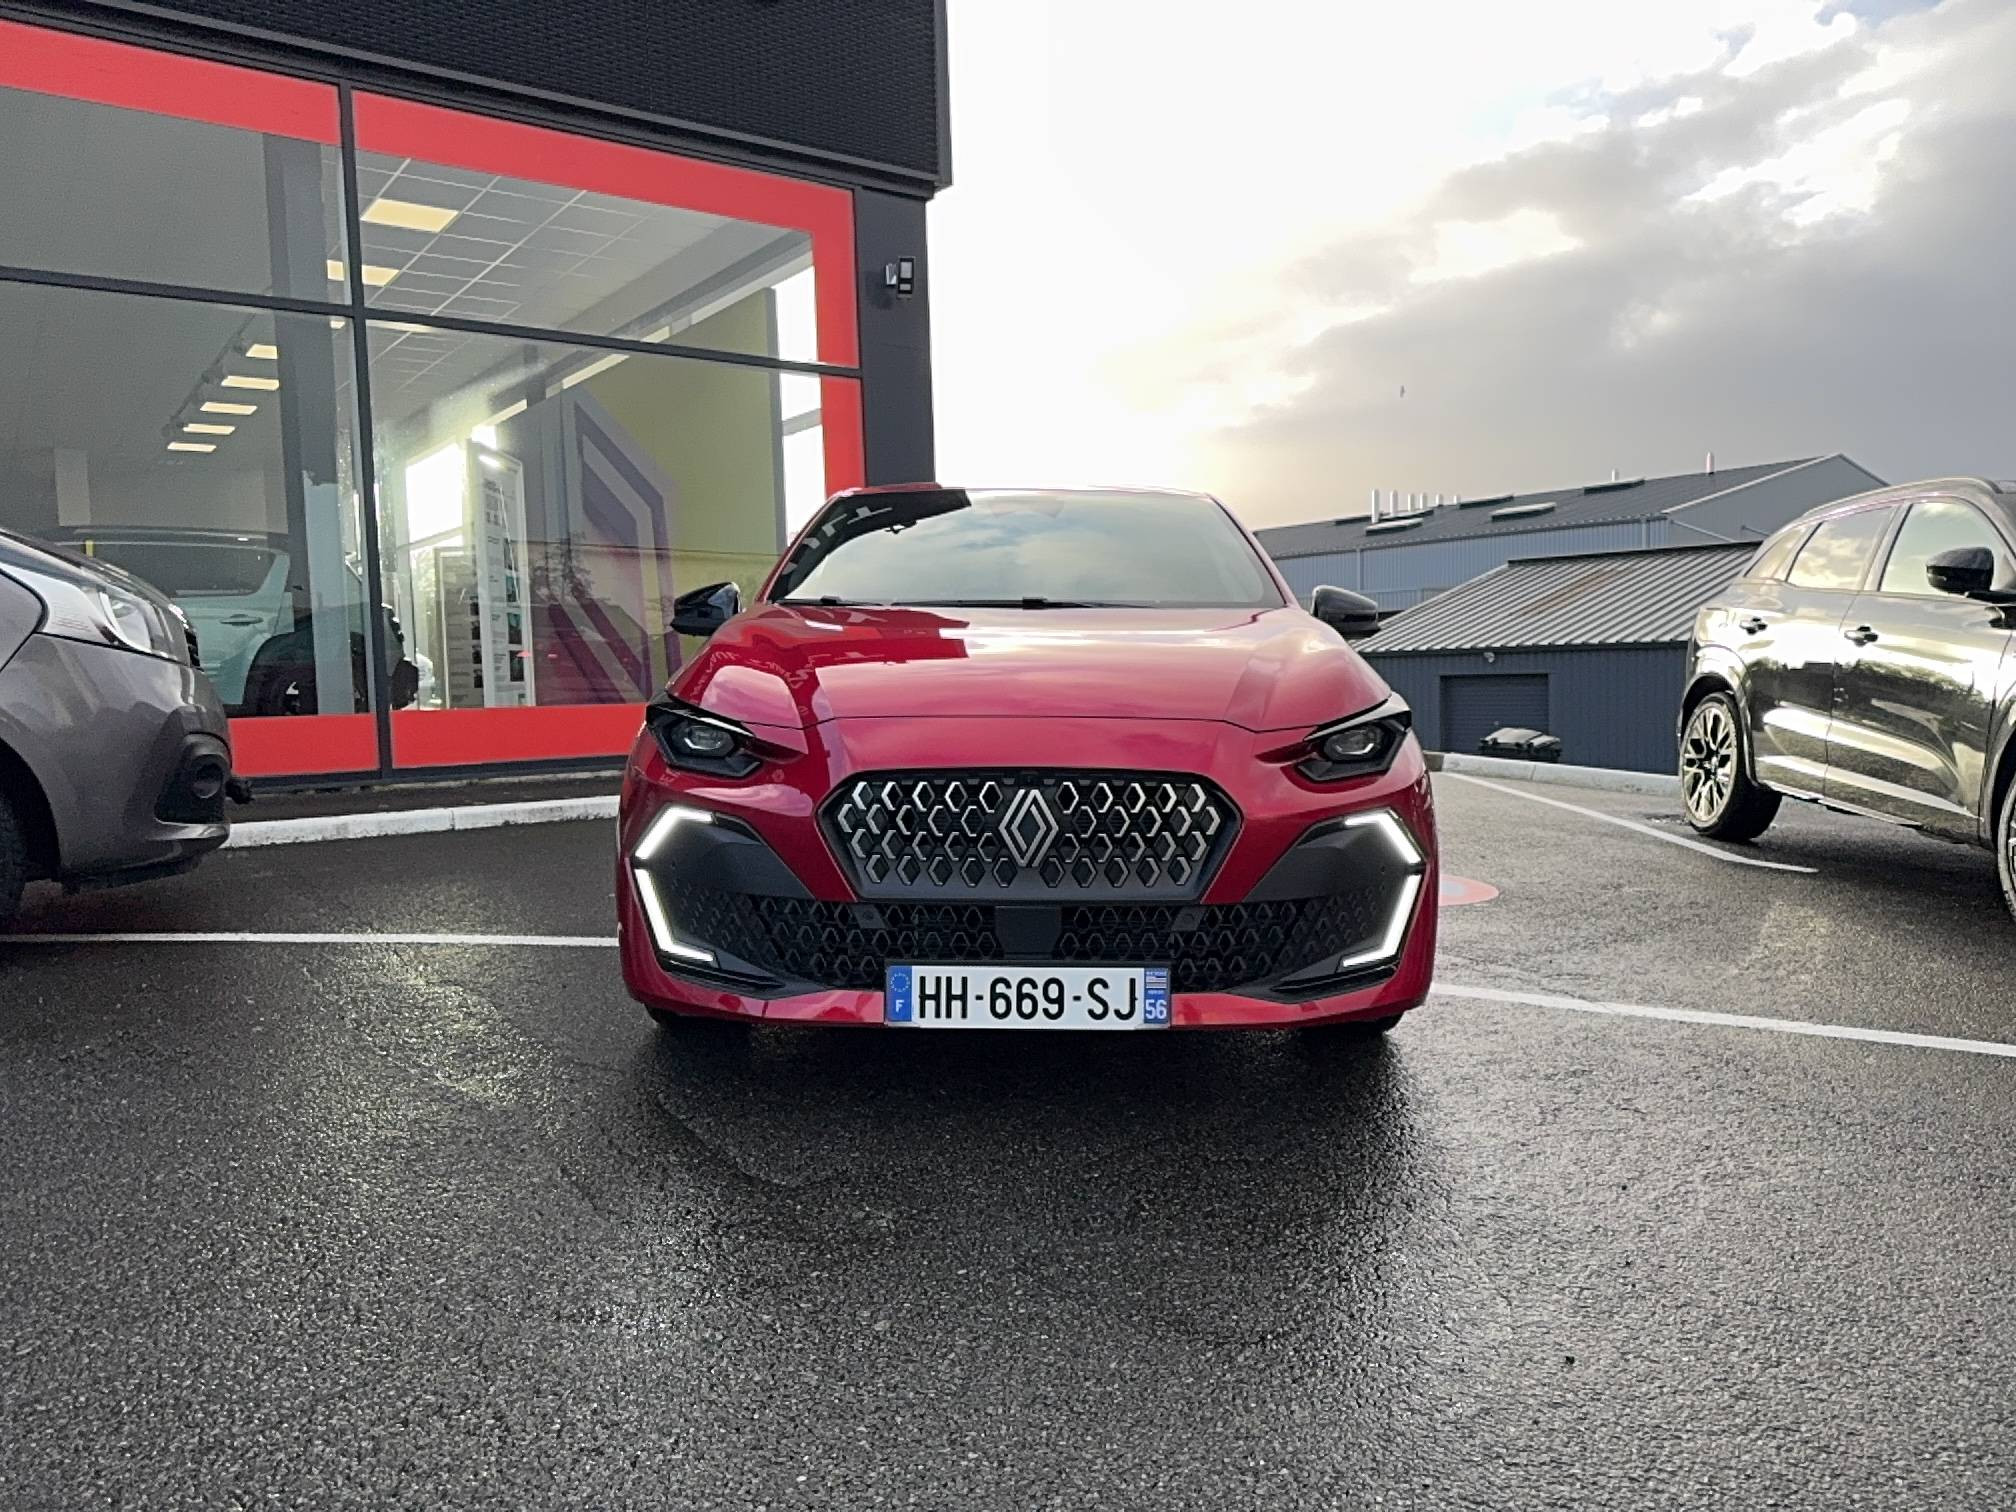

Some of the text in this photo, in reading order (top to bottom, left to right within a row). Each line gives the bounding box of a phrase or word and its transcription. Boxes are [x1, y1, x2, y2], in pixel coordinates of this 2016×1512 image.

[896, 999, 904, 1013] F
[918, 976, 1137, 1021] HH-669-SJ
[1145, 999, 1167, 1020] 56
